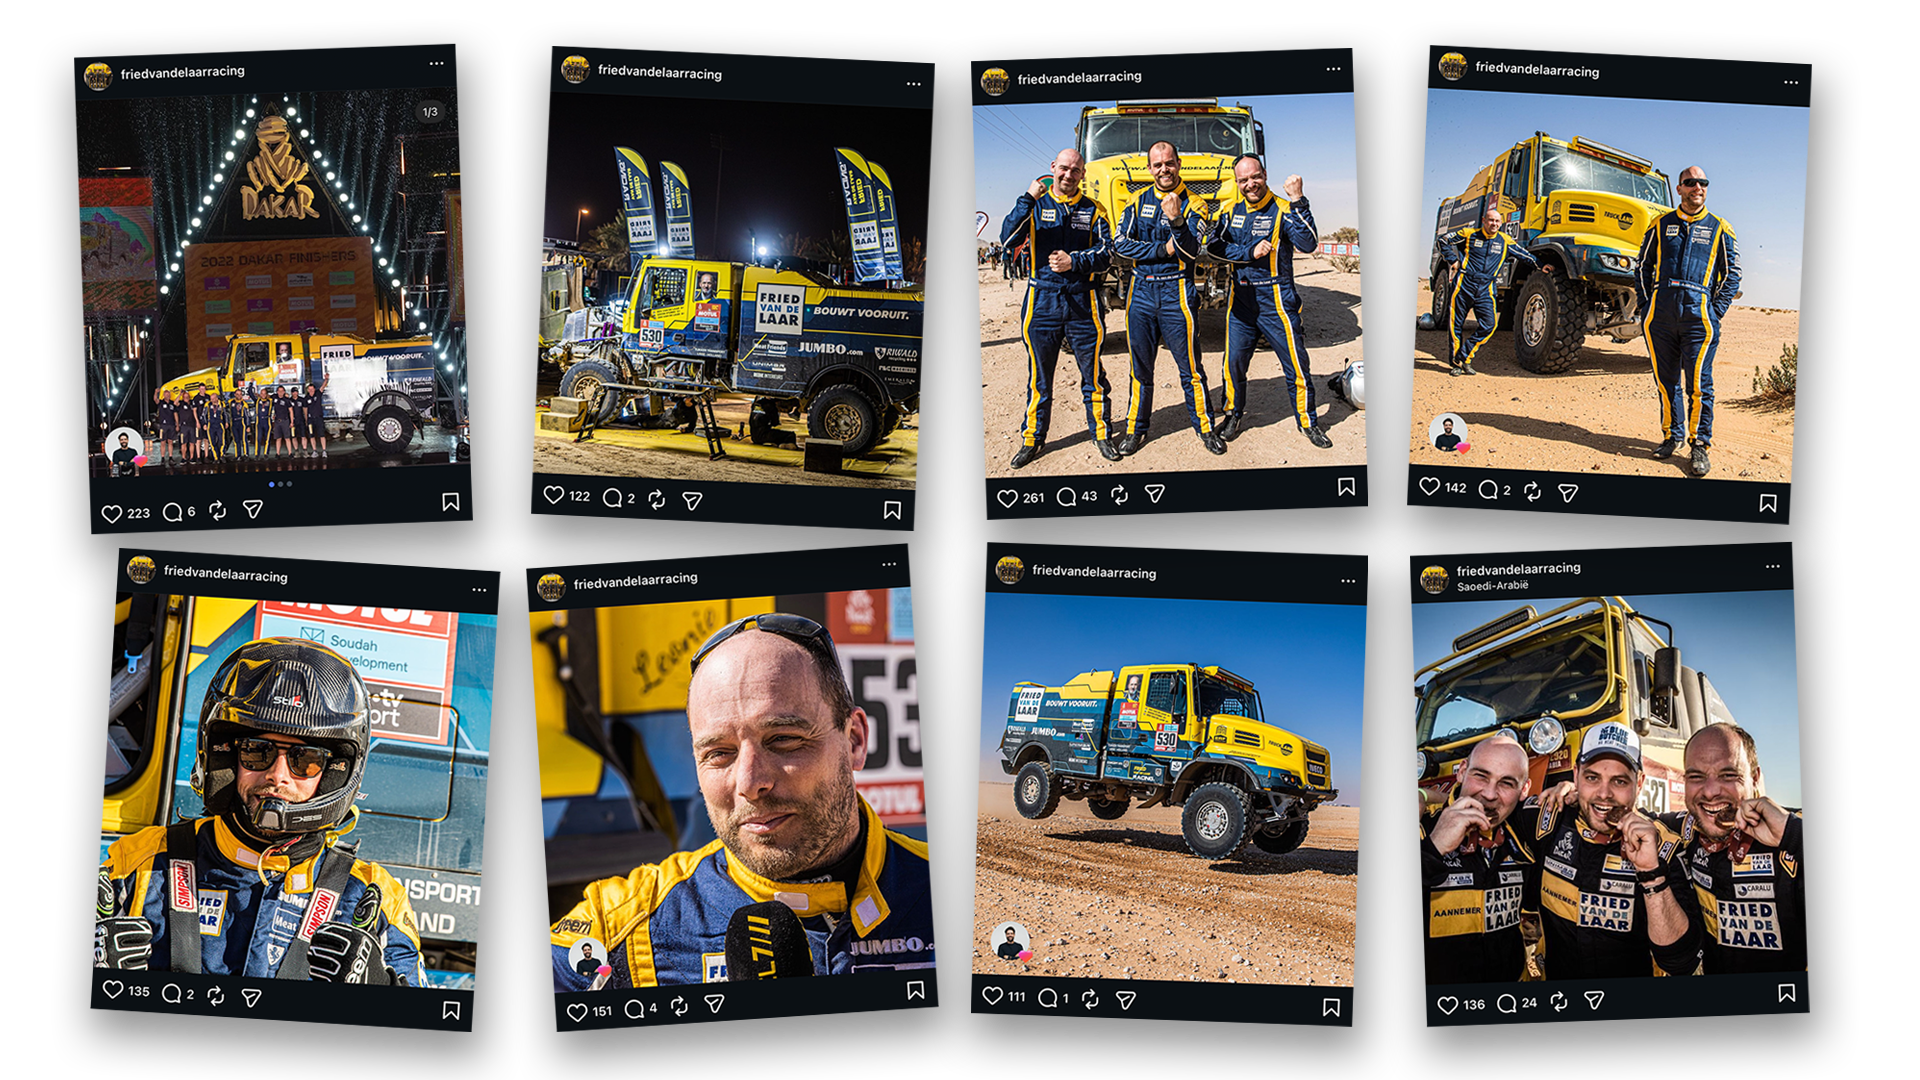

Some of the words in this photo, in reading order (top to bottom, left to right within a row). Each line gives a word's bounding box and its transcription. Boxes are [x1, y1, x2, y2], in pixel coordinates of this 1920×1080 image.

[240, 184, 320, 221] DAKAR
[201, 255, 234, 268] 2022
[239, 253, 284, 266] DAKAR
[289, 250, 357, 264] FINISHERS
[760, 292, 801, 304] FRIED
[759, 303, 782, 313] VAN
[786, 305, 800, 314] DE
[813, 306, 856, 317] BOUWT
[857, 308, 909, 320] VOORUIT.
[759, 313, 799, 326] LAAR
[641, 329, 663, 343] 530
[323, 350, 352, 358] FRIED
[330, 635, 378, 652] Soudah
[1017, 706, 1038, 716] LAAR
[1068, 700, 1098, 708] VOORUIT.
[1156, 732, 1176, 746] 530
[176, 864, 191, 907] SIMPSON
[1486, 886, 1521, 904] FRIED
[1542, 886, 1578, 908] AANNEMER
[1581, 893, 1631, 910] FRIED
[306, 893, 332, 936] SIMPSON
[1433, 906, 1482, 918] AANNEMER
[1486, 902, 1508, 915] VAN
[1580, 906, 1607, 918] VAN
[1612, 911, 1628, 920] DE
[1719, 902, 1773, 918] FRIED
[1485, 909, 1520, 931] LAAR
[1580, 914, 1629, 931] LAAR
[1720, 916, 1748, 930] VAN
[1754, 920, 1774, 931] DE
[1720, 929, 1780, 949] LAAR
